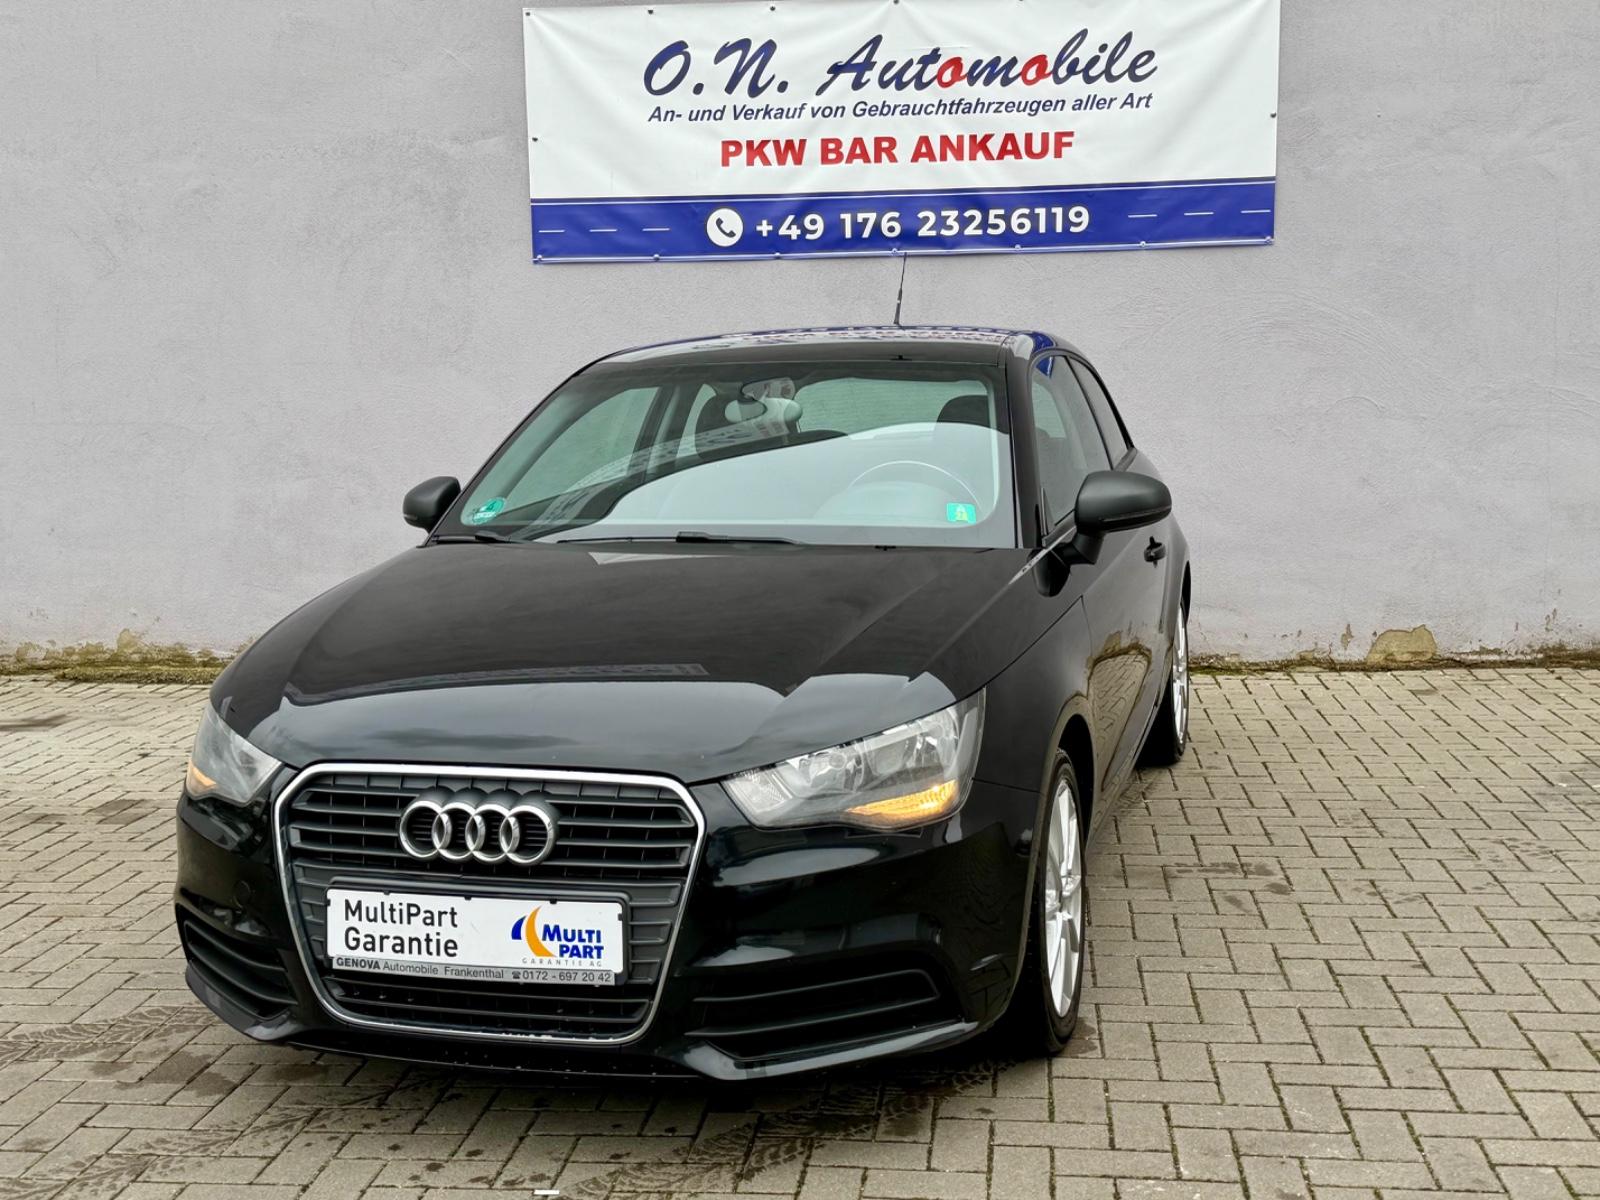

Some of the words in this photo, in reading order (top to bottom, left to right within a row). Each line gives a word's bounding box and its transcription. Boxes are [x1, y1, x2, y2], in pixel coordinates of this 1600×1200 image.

[815, 28, 1158, 97] Automobile
[648, 106, 682, 123] An-
[688, 104, 726, 122] und
[732, 103, 808, 121] Verkauf
[810, 105, 846, 119] von
[852, 97, 1066, 118] Gebrauchtfahrzeugen
[1071, 94, 1118, 112] aller
[1119, 92, 1154, 110] Art
[721, 138, 807, 168] PKW
[820, 135, 899, 165] BAR
[910, 131, 1075, 164] ANKAUF
[755, 213, 825, 241] +49
[840, 210, 901, 239] 176
[917, 205, 1090, 238] 23256119
[344, 898, 458, 928] MultiPart
[344, 926, 458, 957] Garantie
[541, 923, 603, 944] MULTI
[521, 956, 583, 968] GARANTIE
[590, 959, 603, 968] AG
[558, 943, 605, 960] PART
[336, 956, 381, 971] GENOVA
[382, 961, 439, 976] Automobile
[443, 965, 504, 980] Frankenthal
[522, 970, 549, 981] 0172
[558, 971, 579, 982] 697
[581, 972, 595, 983] 20
[597, 972, 612, 983] 42
